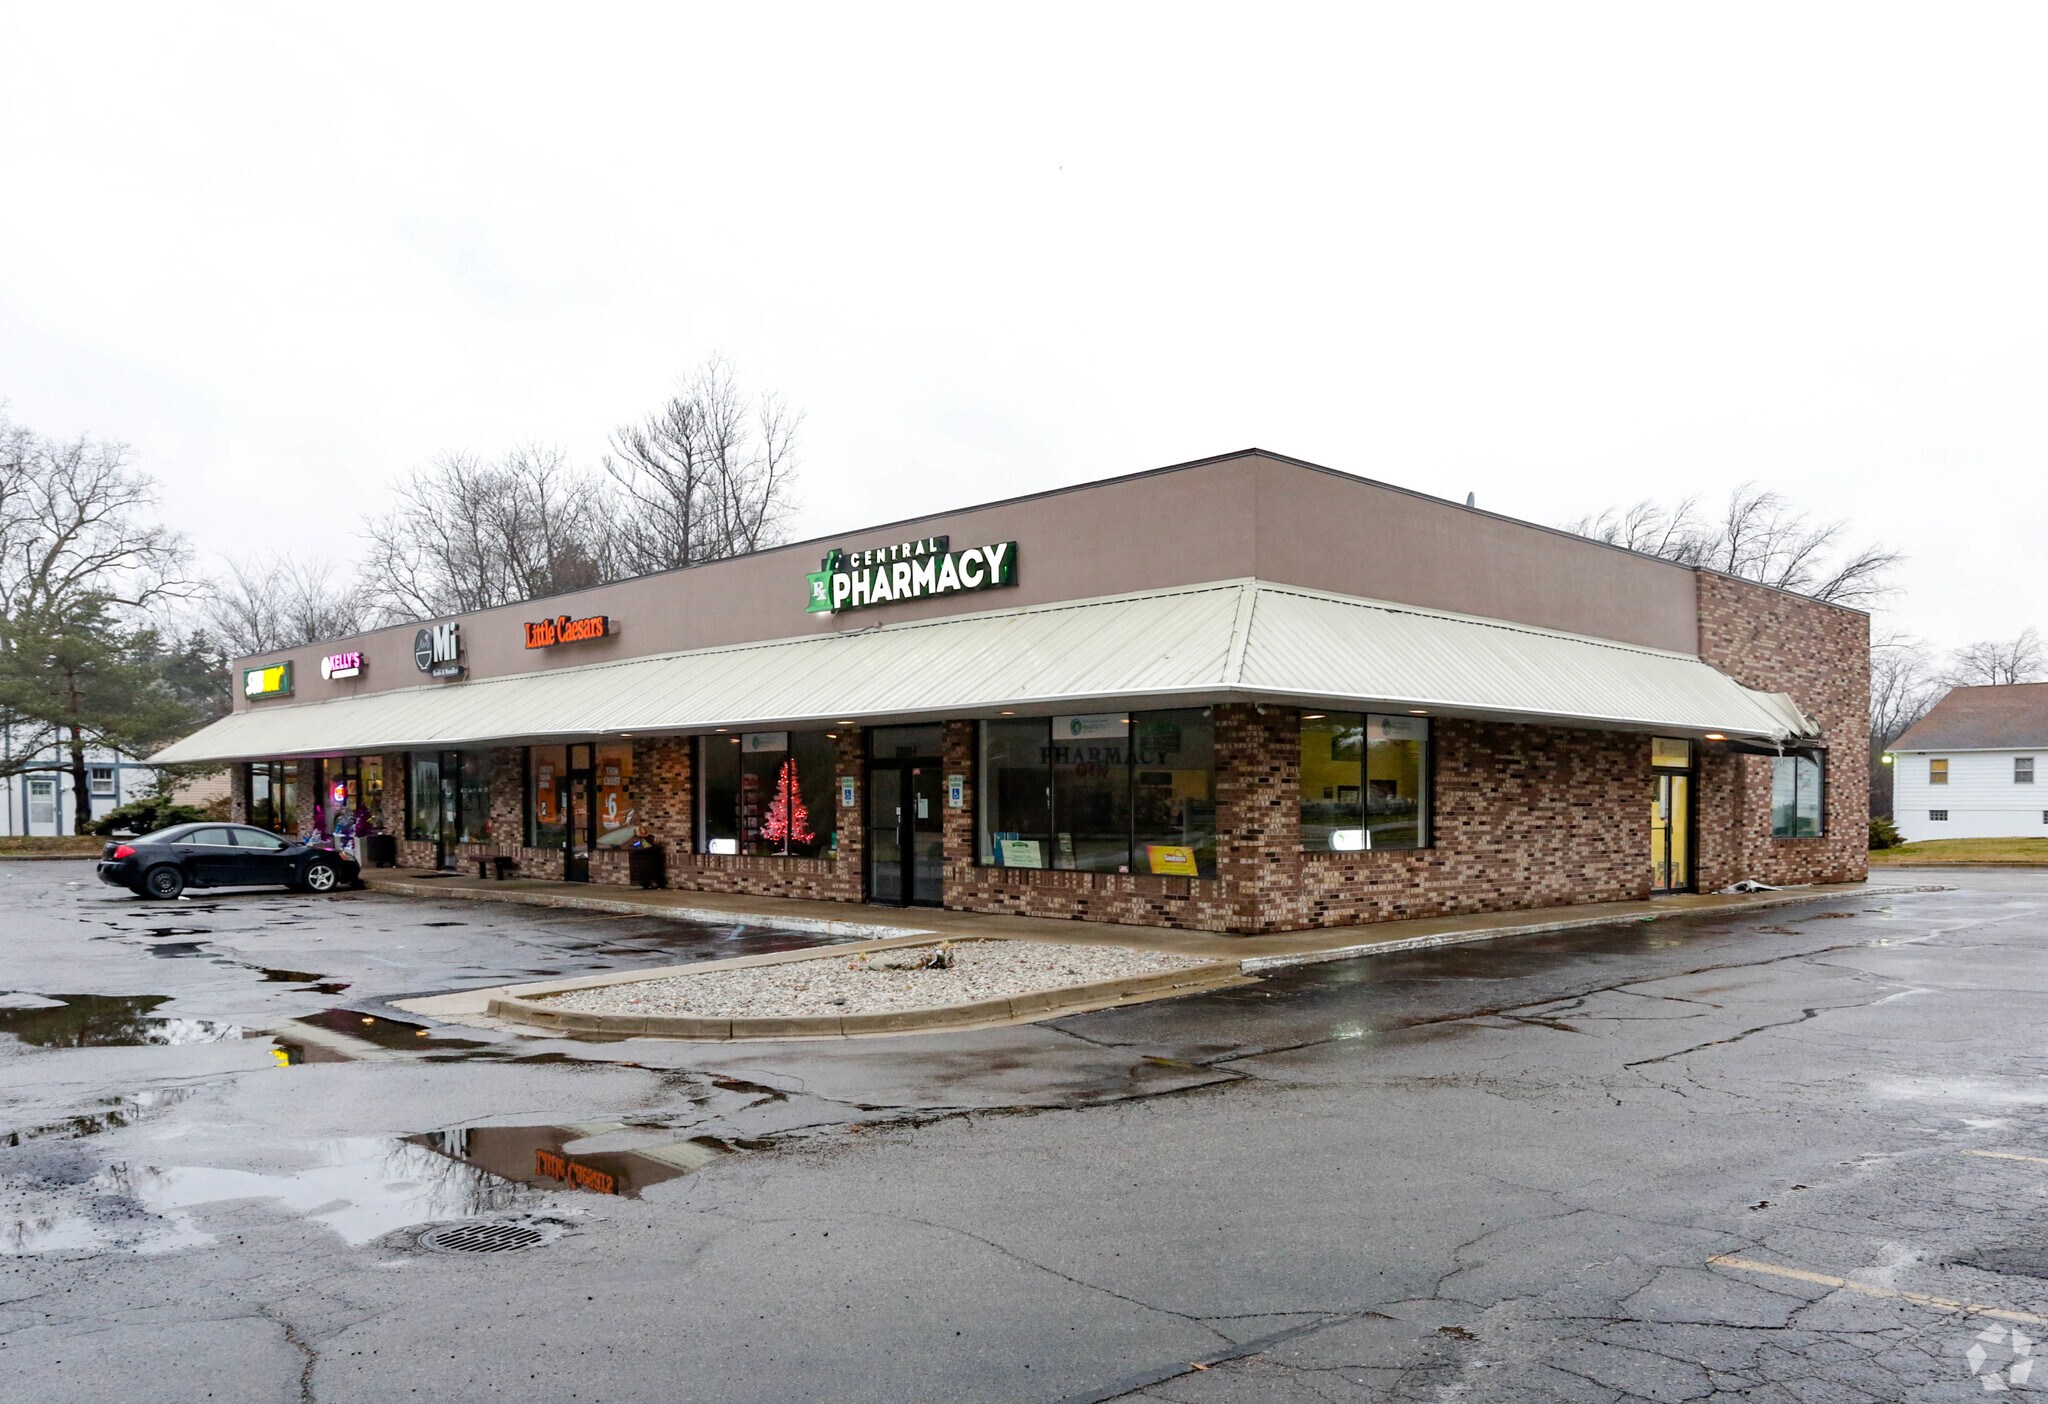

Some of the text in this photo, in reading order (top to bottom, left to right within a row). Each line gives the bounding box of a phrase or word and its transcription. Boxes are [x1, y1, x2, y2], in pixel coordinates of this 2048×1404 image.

[850, 537, 938, 568] CENTRAL
[832, 542, 1008, 609] PHARMACY
[433, 621, 457, 663] Mi
[524, 615, 604, 649] Little Caesars
[329, 651, 360, 671] KELLY'S
